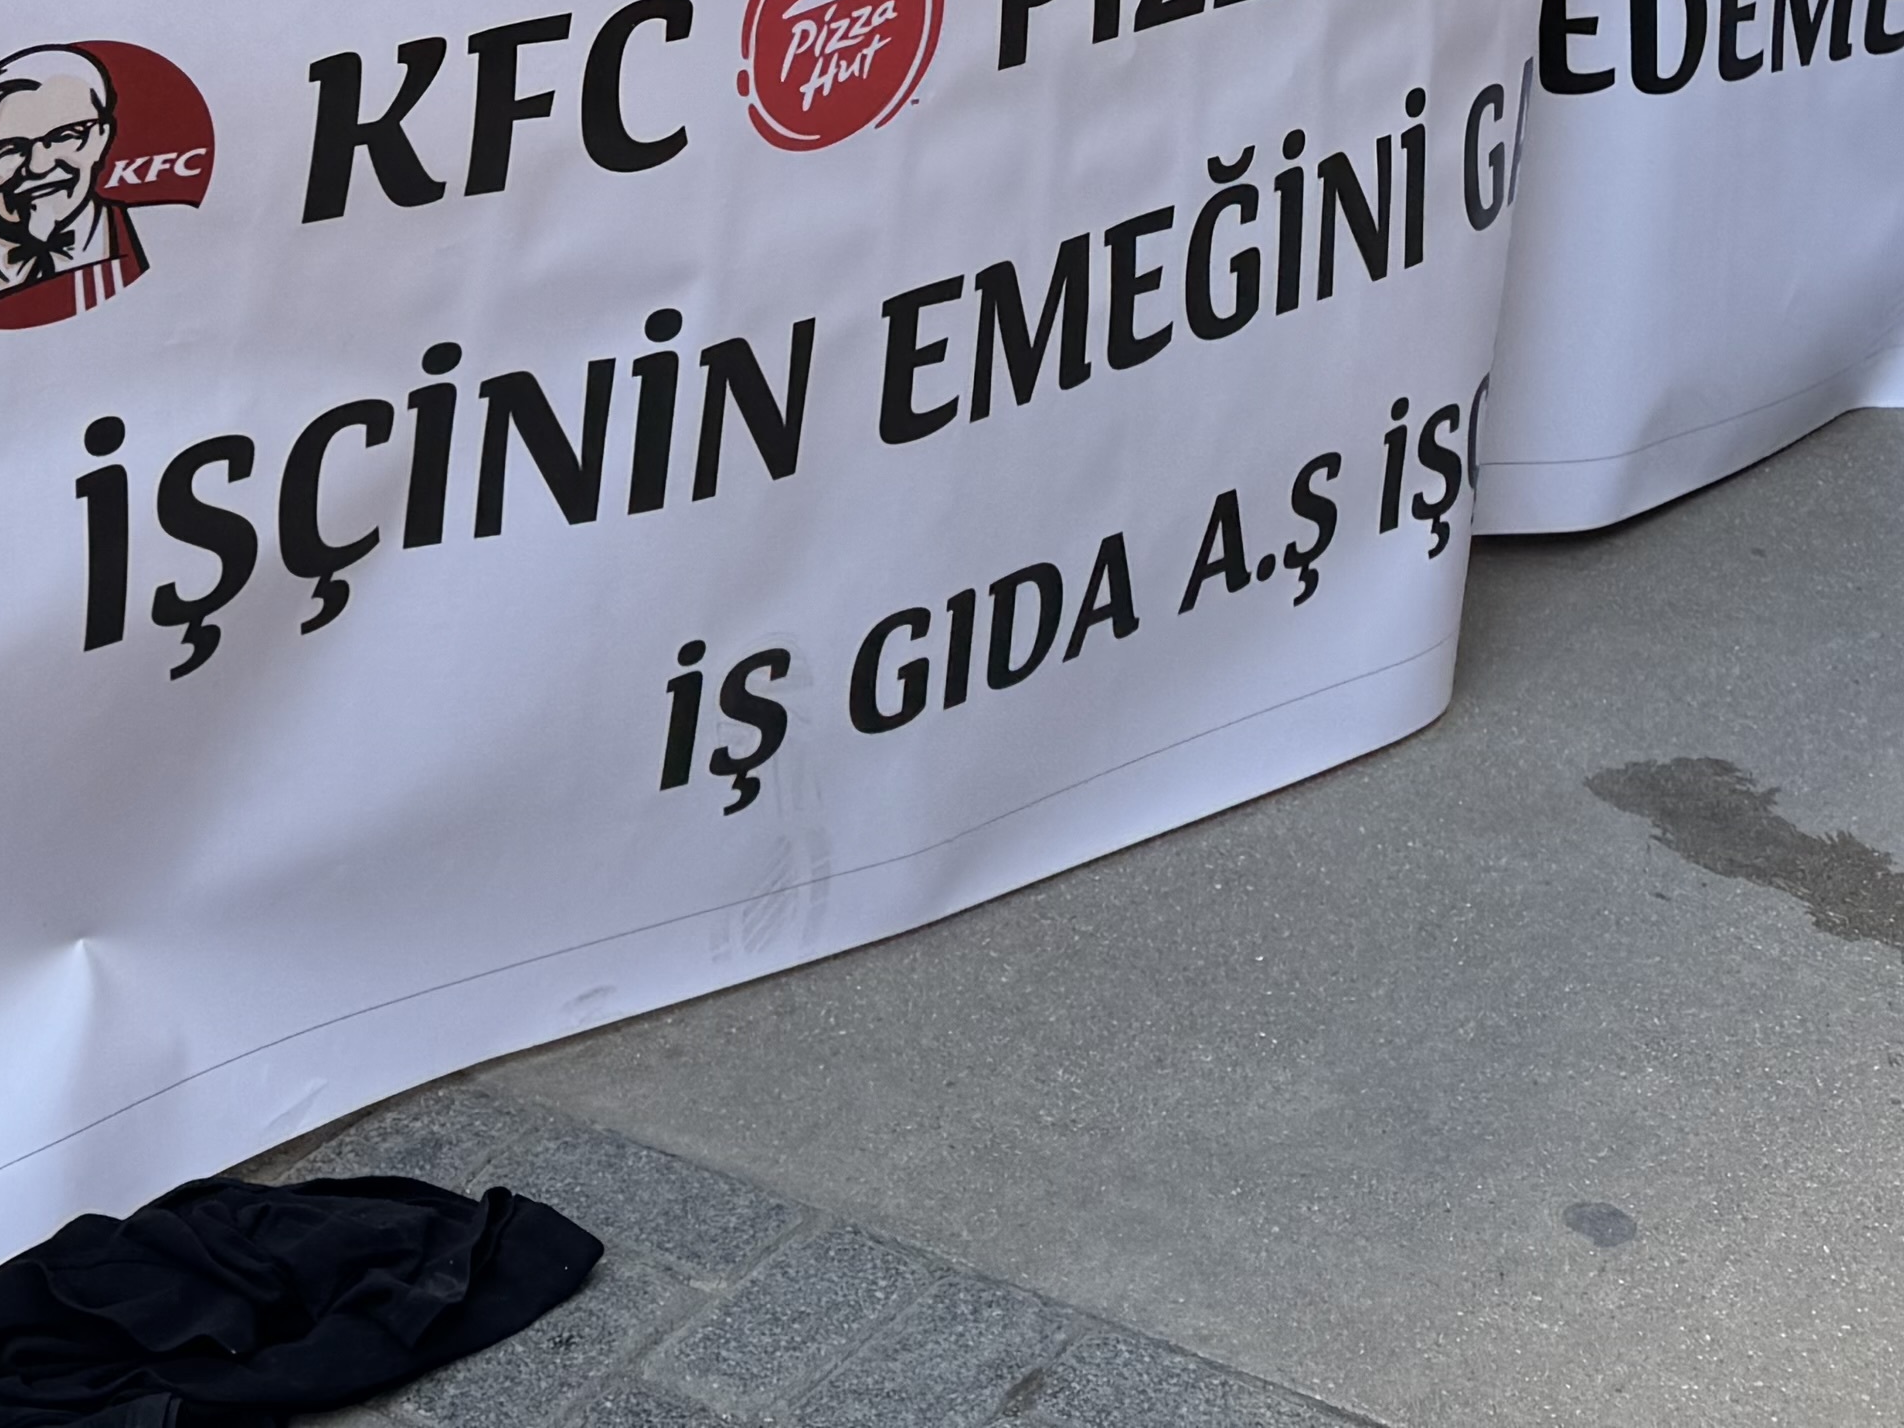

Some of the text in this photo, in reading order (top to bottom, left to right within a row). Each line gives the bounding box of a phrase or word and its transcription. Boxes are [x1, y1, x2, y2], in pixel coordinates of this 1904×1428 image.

[100, 147, 208, 190] KFC
[799, 37, 893, 115] Hut
[73, 304, 820, 684] İŞÇİNİN
[876, 84, 1430, 452] EMEĞİNİ
[655, 447, 1346, 819] İŞ GIDA A.Ş
